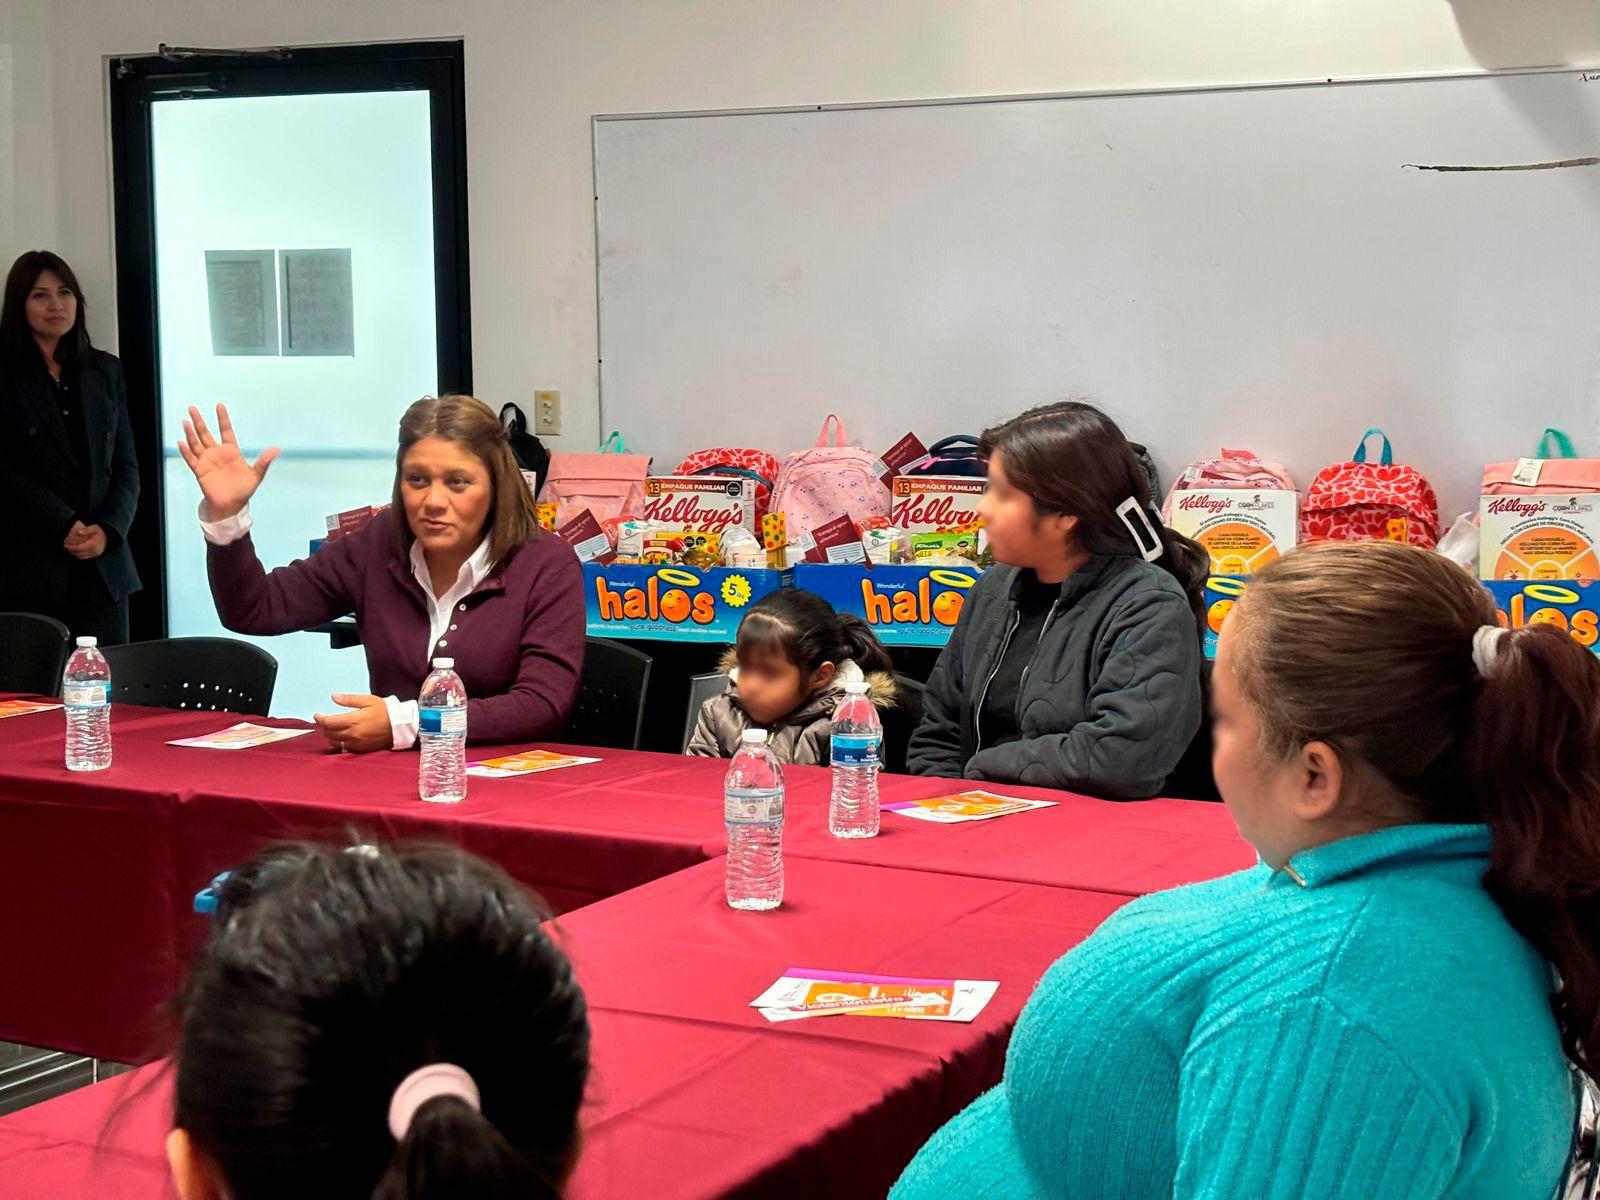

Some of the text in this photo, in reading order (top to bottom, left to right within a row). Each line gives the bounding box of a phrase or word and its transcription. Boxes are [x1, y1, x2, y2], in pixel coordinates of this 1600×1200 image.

[649, 483, 660, 493] 13
[694, 483, 725, 491] FAMILIAR
[899, 483, 910, 493] 13
[948, 484, 982, 492] FAMILIAR
[644, 493, 742, 533] Kellogg's
[892, 493, 981, 529] Kellog
[1179, 494, 1232, 513] Kellogg's
[1487, 497, 1547, 517] Kellogg's
[728, 583, 737, 596] 5
[596, 575, 715, 625] halos
[861, 577, 965, 627] halo
